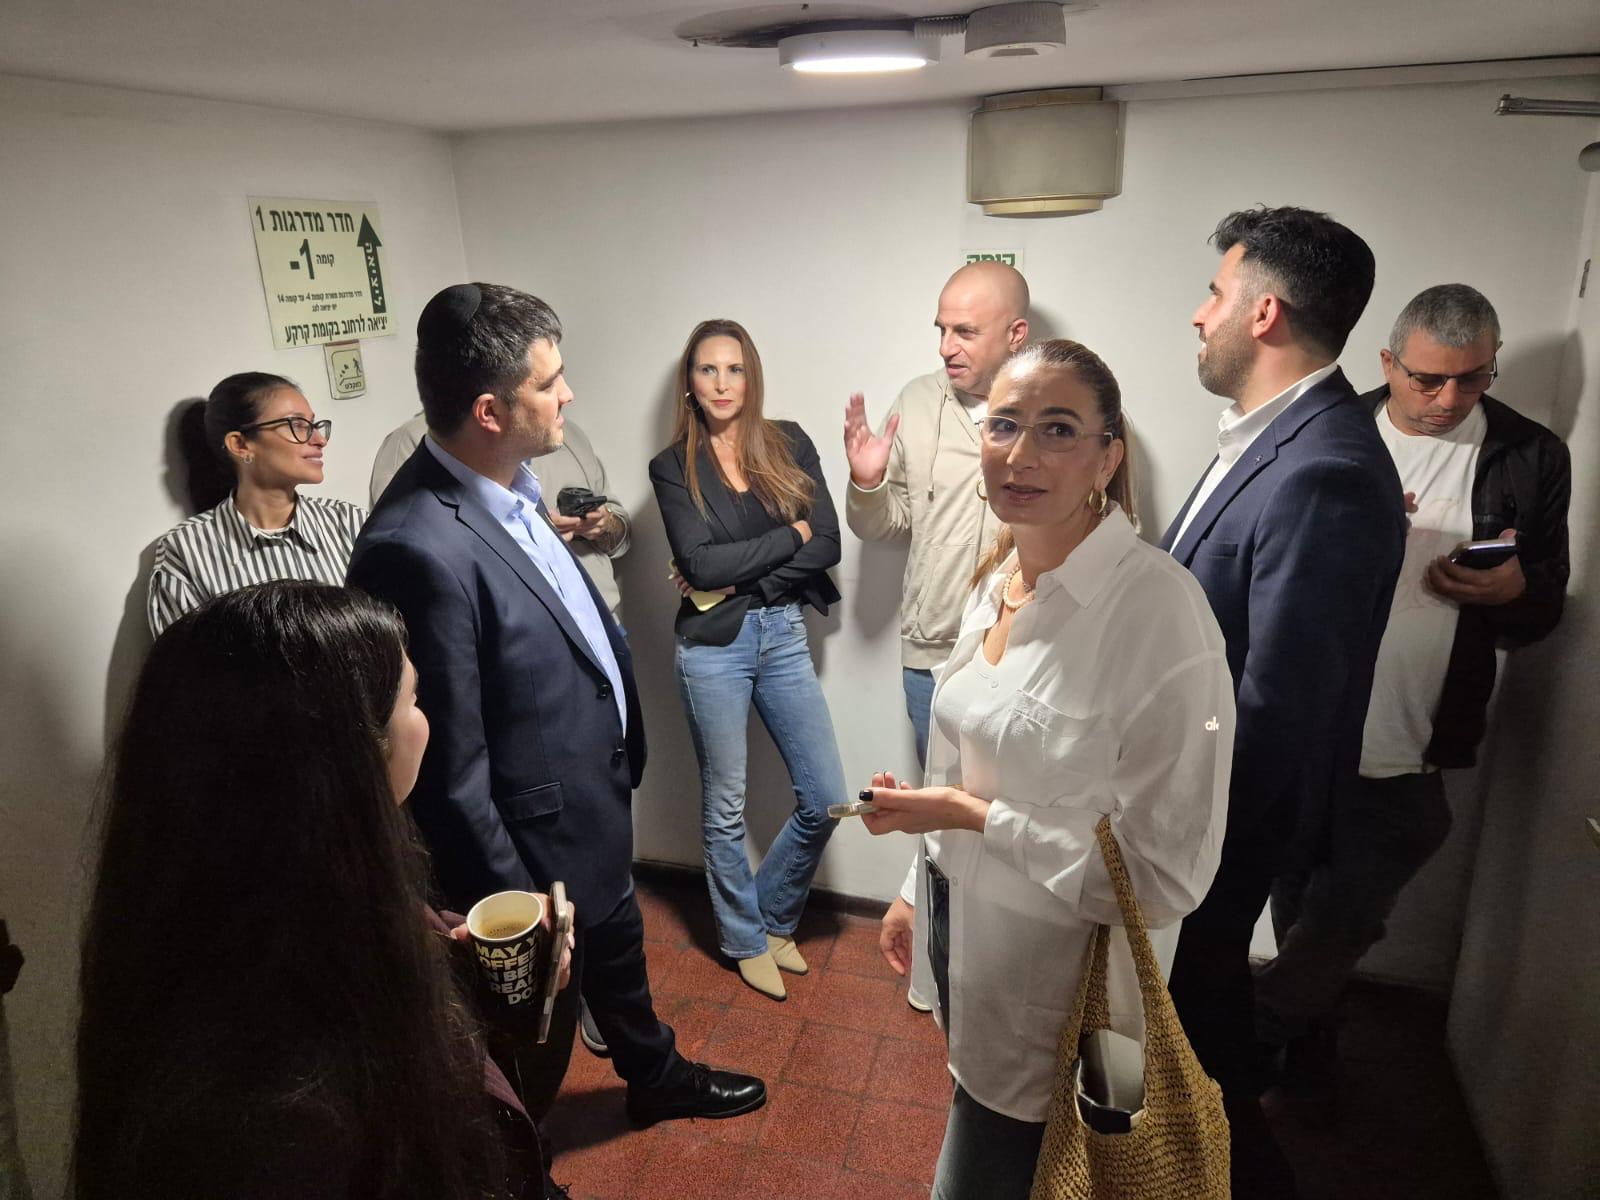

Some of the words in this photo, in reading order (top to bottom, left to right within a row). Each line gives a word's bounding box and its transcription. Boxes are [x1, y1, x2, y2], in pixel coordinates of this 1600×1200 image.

[255, 204, 265, 232] 1
[269, 209, 325, 233] מדרגות
[326, 212, 355, 233] חדר
[316, 253, 335, 267] קומה
[277, 293, 285, 303] 14
[285, 294, 297, 304] קומה
[312, 320, 340, 341] בקומת
[341, 313, 365, 335] לרחוב
[367, 316, 388, 331] יציאה
[285, 323, 310, 346] קרקע
[474, 941, 522, 960] MAY
[480, 944, 537, 971] OFFEE
